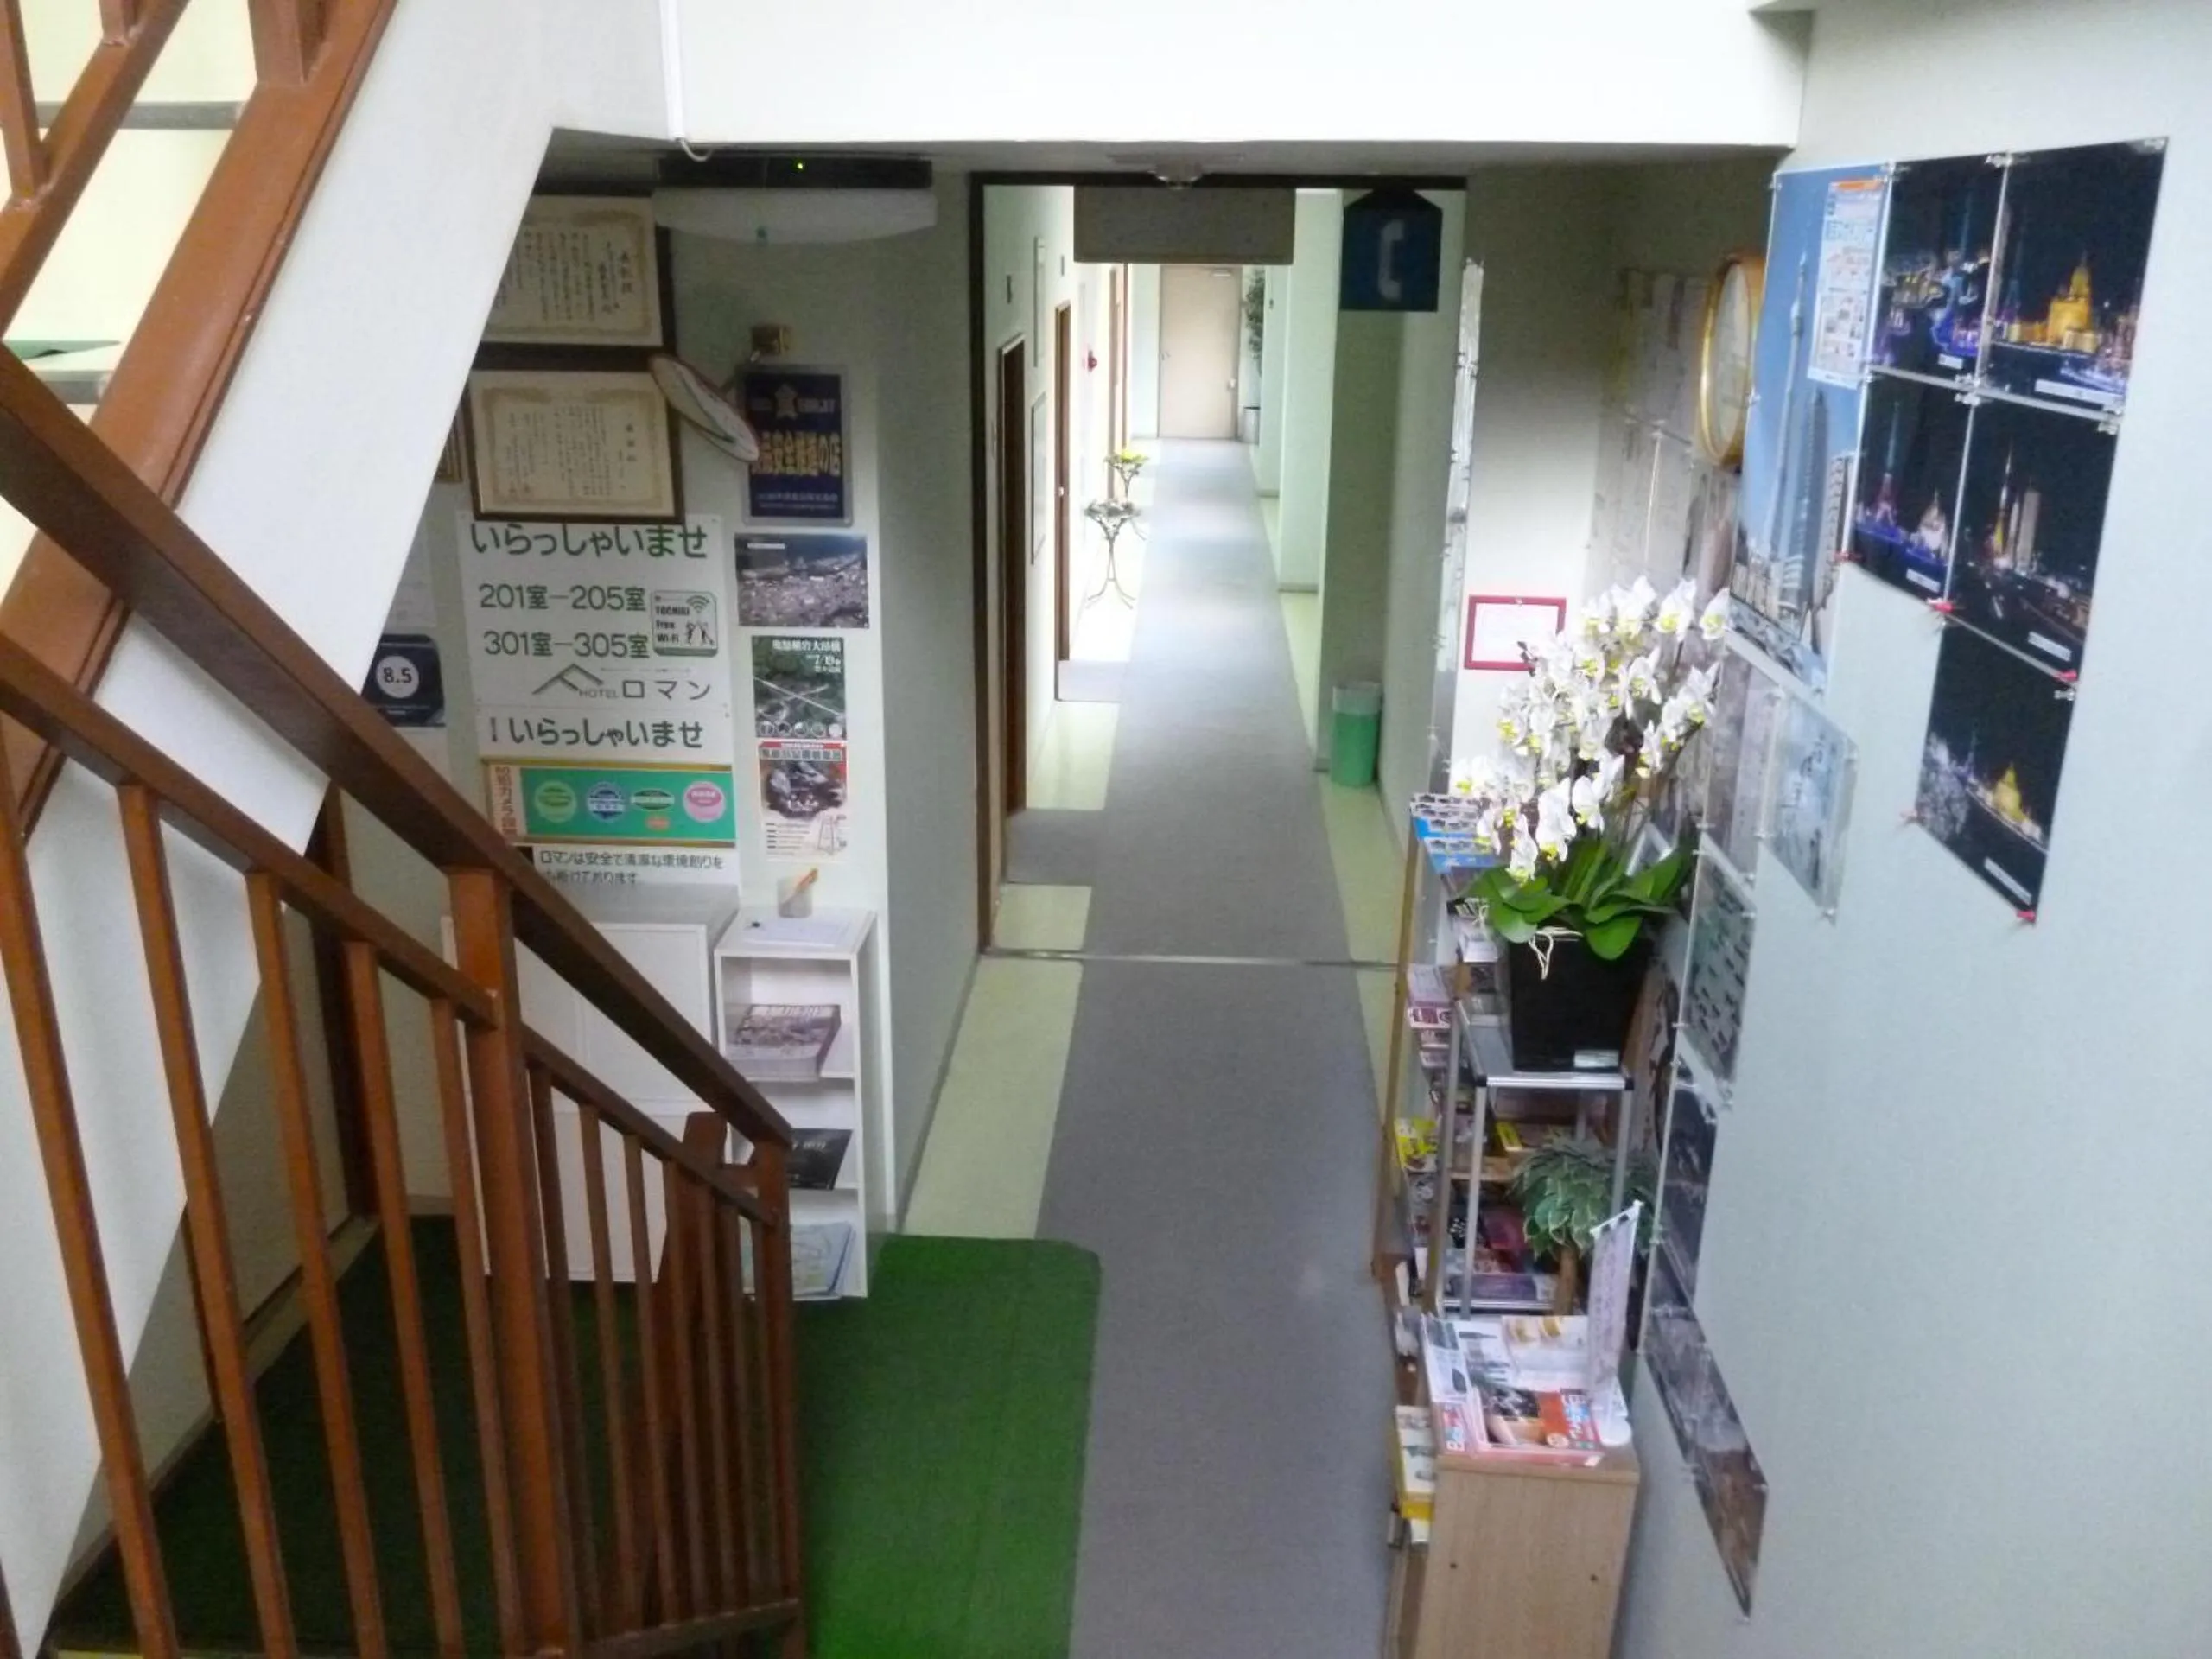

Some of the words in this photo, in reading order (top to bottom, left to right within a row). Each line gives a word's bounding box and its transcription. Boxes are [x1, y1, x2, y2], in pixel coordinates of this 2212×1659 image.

[471, 523, 708, 558] いらっしゃいませ
[383, 667, 412, 683] 8.5
[579, 688, 619, 698] HOTEL
[622, 680, 710, 700] ロマン
